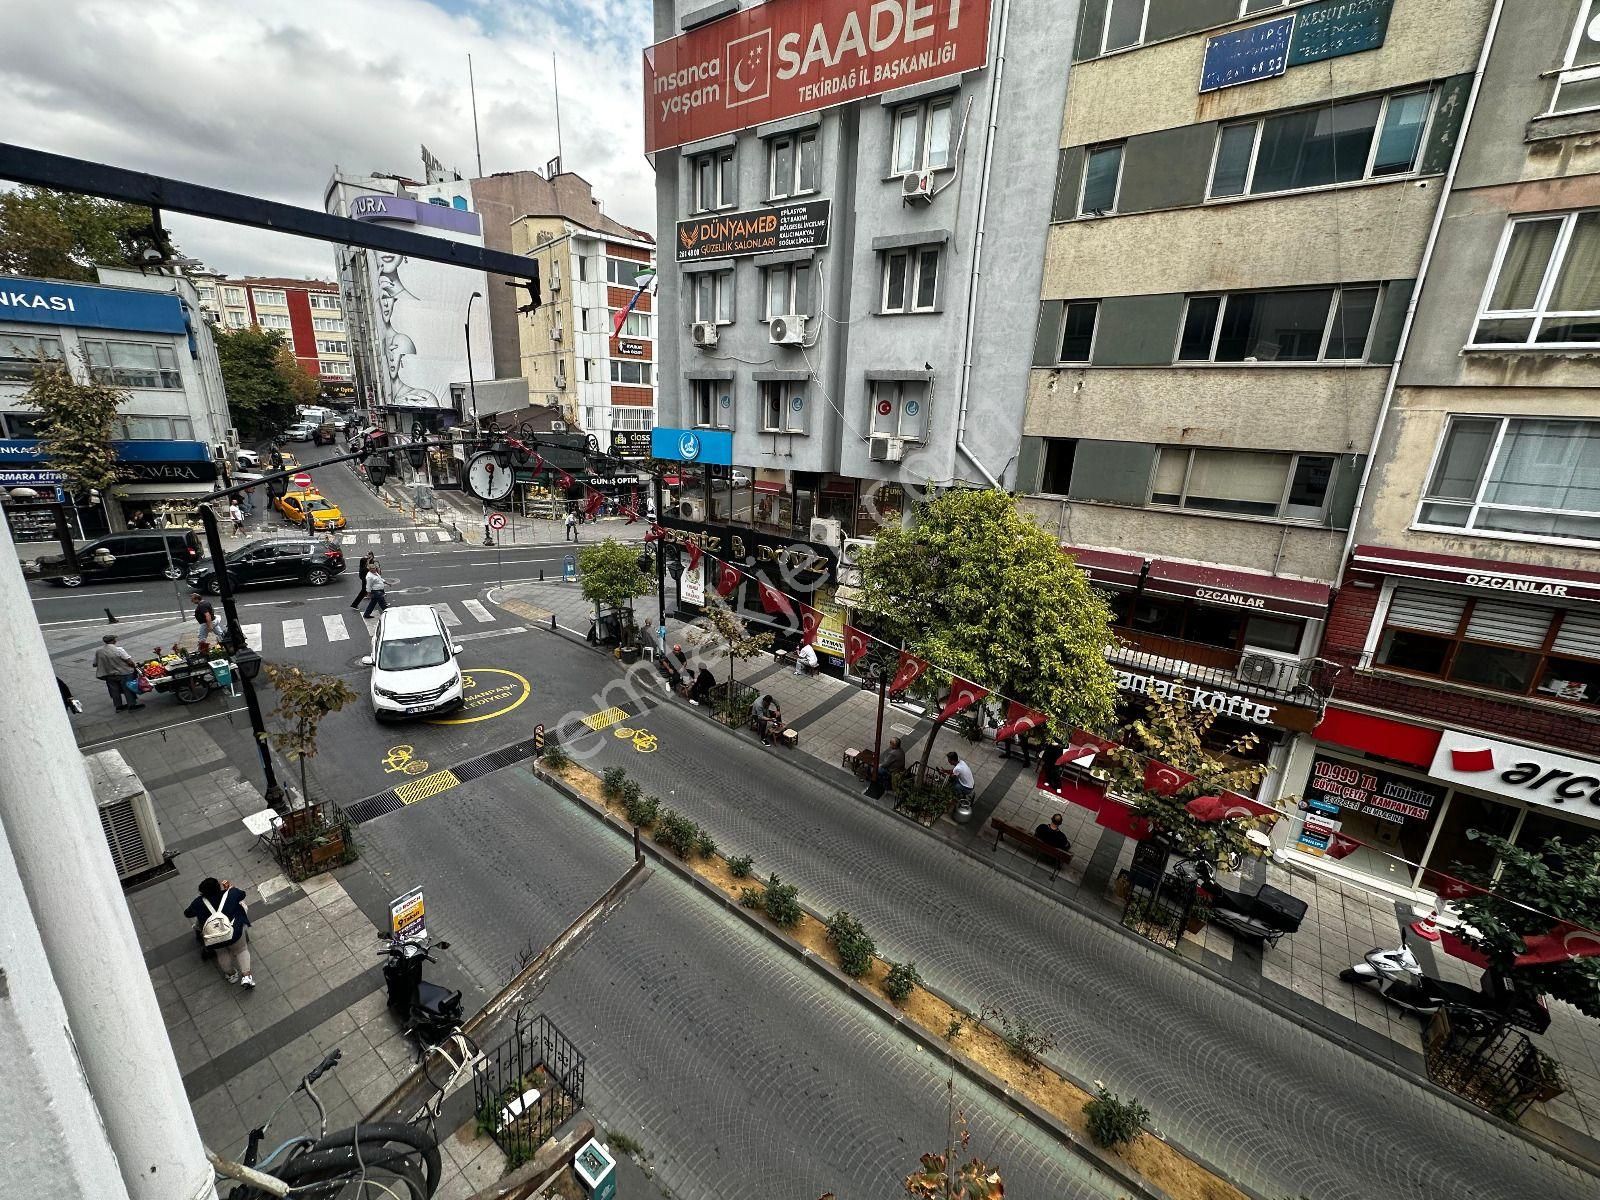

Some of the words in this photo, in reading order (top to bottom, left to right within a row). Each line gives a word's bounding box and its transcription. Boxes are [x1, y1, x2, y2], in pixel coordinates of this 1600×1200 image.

[775, 0, 961, 80] SAADET
[798, 66, 857, 103] TEKİRDAĞ
[858, 63, 872, 86] İL
[873, 41, 957, 84] BAŞKANLIĞI
[661, 84, 721, 122] yaşam
[700, 214, 778, 242] DÜNYAMED
[700, 240, 733, 256] GÜZELLİK
[734, 236, 776, 251] SALONLARI
[630, 432, 651, 441] class
[1191, 685, 1272, 725] köfte
[1312, 778, 1343, 795] BÜYÜK
[1342, 785, 1368, 803] ÇEYİZ
[1370, 794, 1430, 820] KAMPANYASI
[1315, 760, 1360, 785] 10.999
[1360, 773, 1378, 792] TL
[1383, 781, 1436, 808] İNDİRİM
